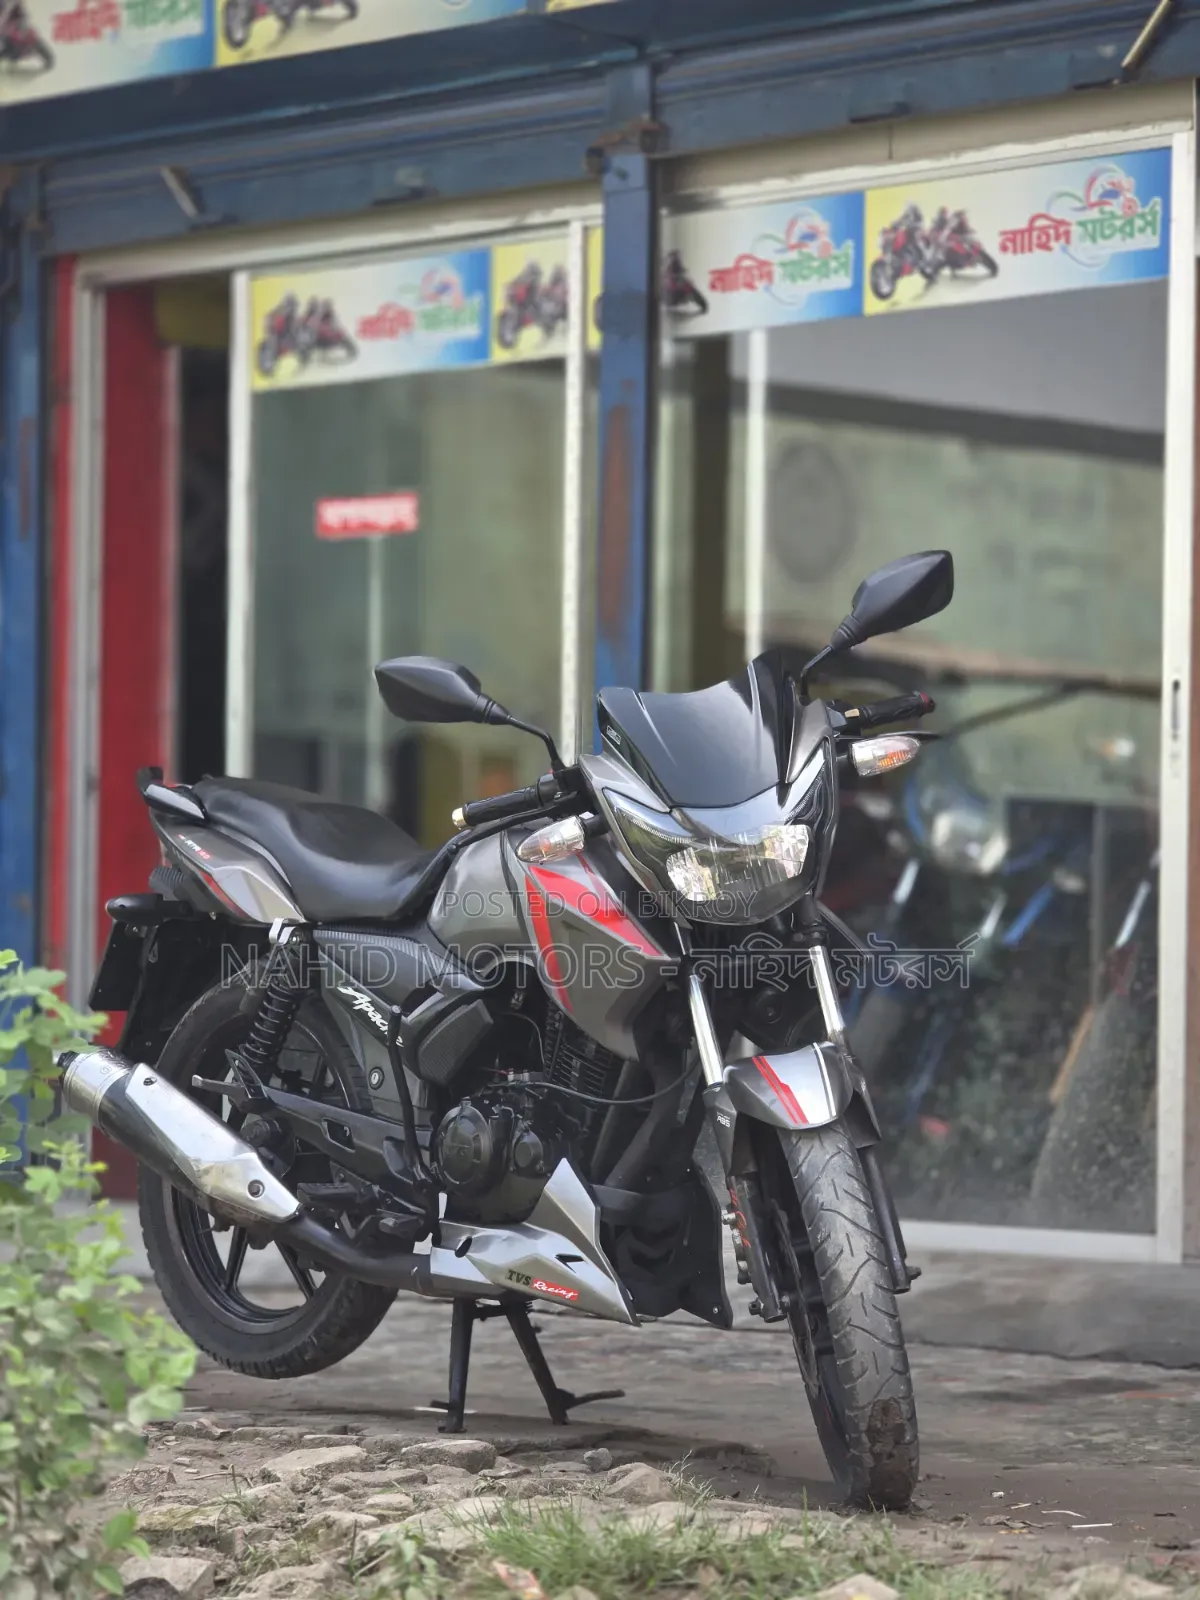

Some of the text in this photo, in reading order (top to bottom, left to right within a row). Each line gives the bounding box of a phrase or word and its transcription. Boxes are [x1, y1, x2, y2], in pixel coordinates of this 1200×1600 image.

[998, 212, 1072, 255] নাহিদ
[336, 986, 404, 1048] Apace
[507, 1269, 578, 1299] TVS Racing
